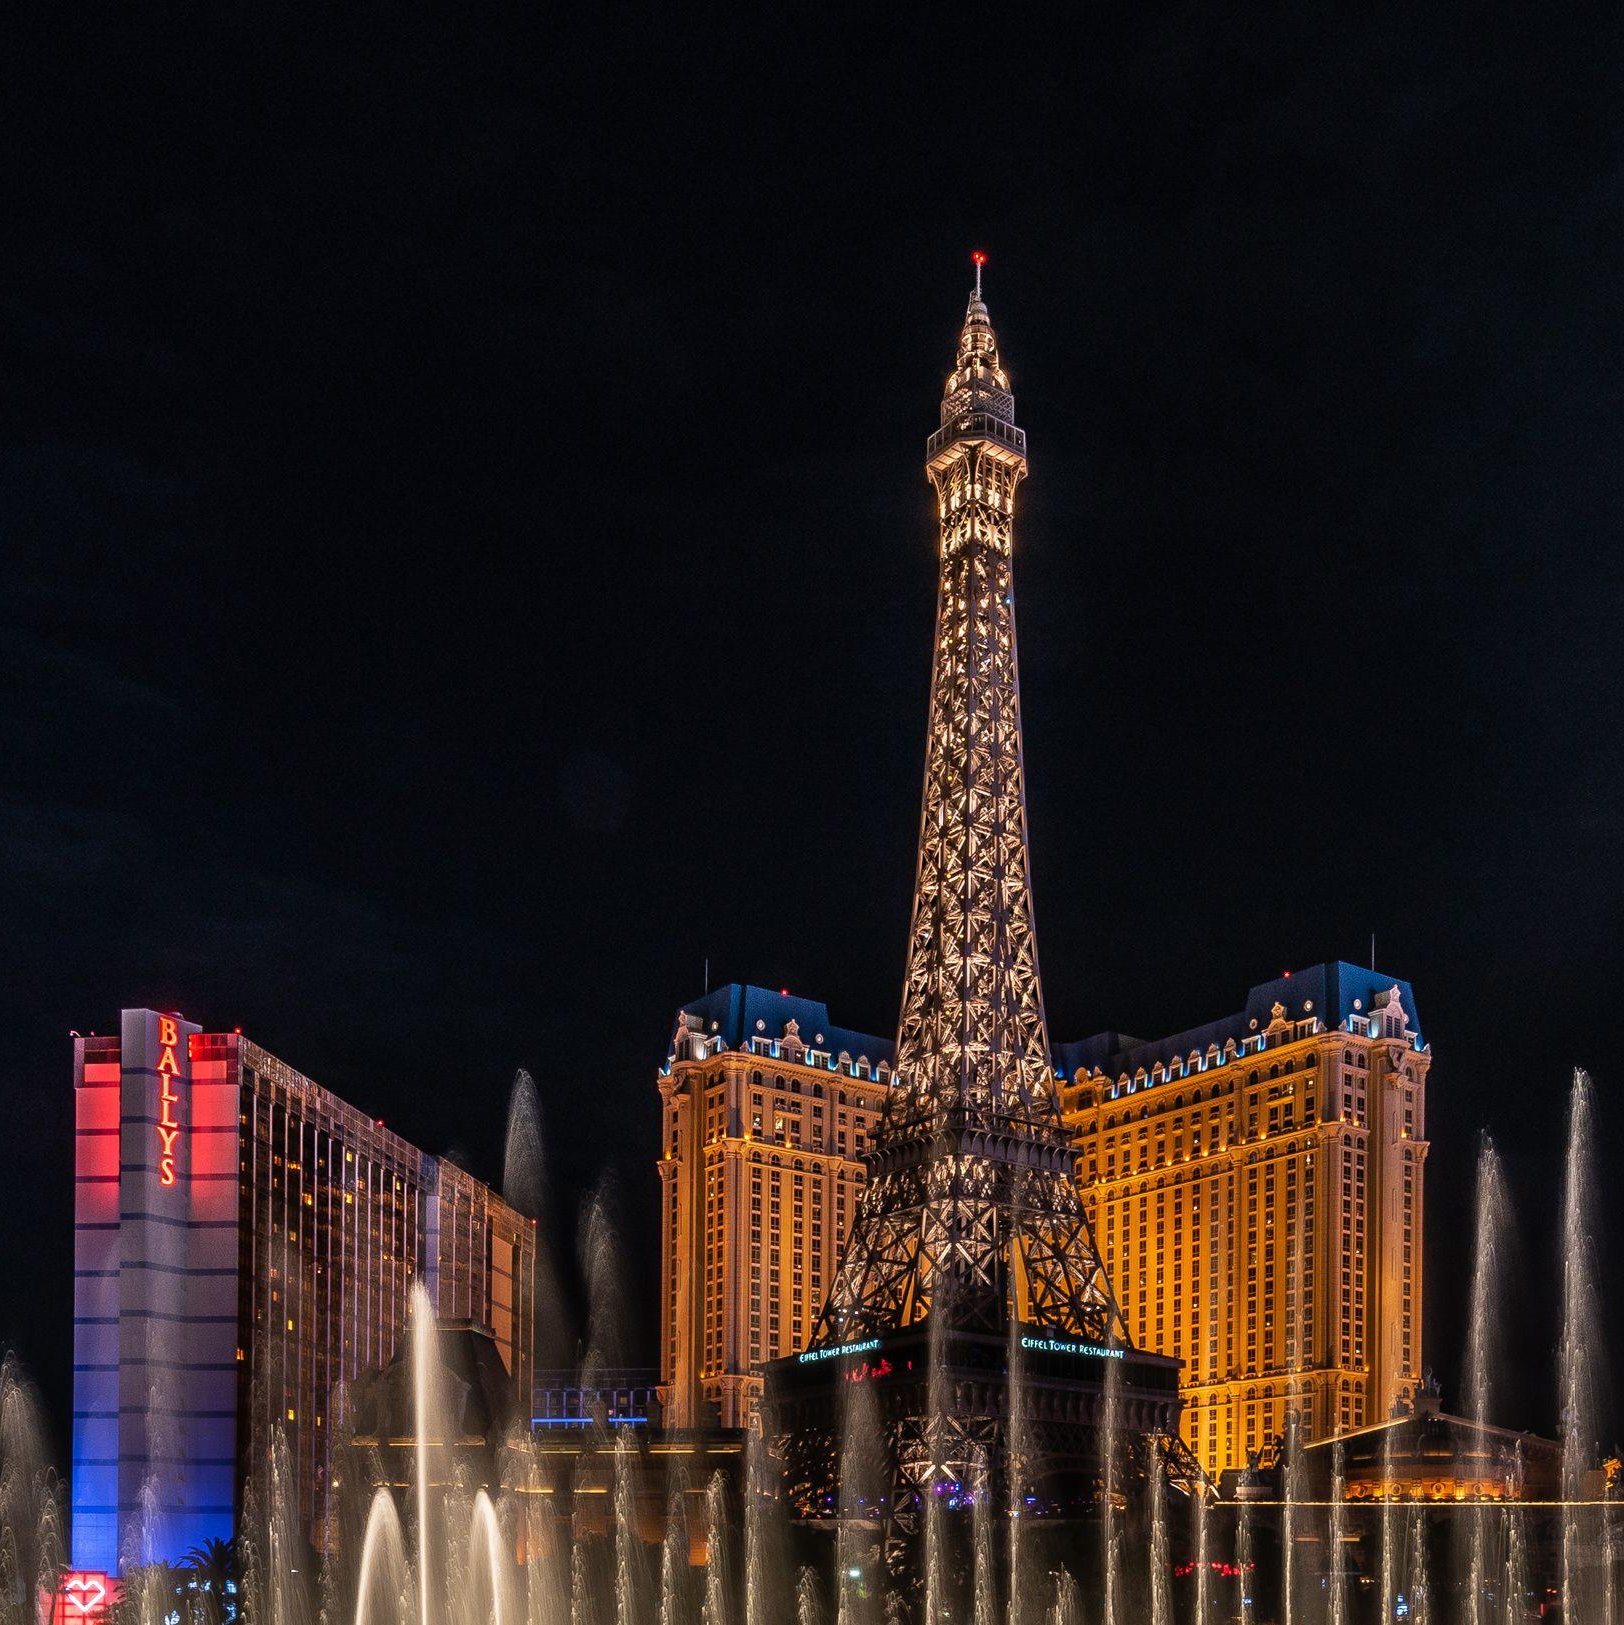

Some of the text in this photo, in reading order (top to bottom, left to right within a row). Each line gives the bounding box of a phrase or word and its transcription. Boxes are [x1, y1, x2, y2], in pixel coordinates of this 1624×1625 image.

[157, 1017, 180, 1185] BALLYS
[800, 1339, 878, 1362] EIFFEL TOWER RESTAURANT
[1021, 1337, 1124, 1359] EIFFEL TOWER RESTAURANT
